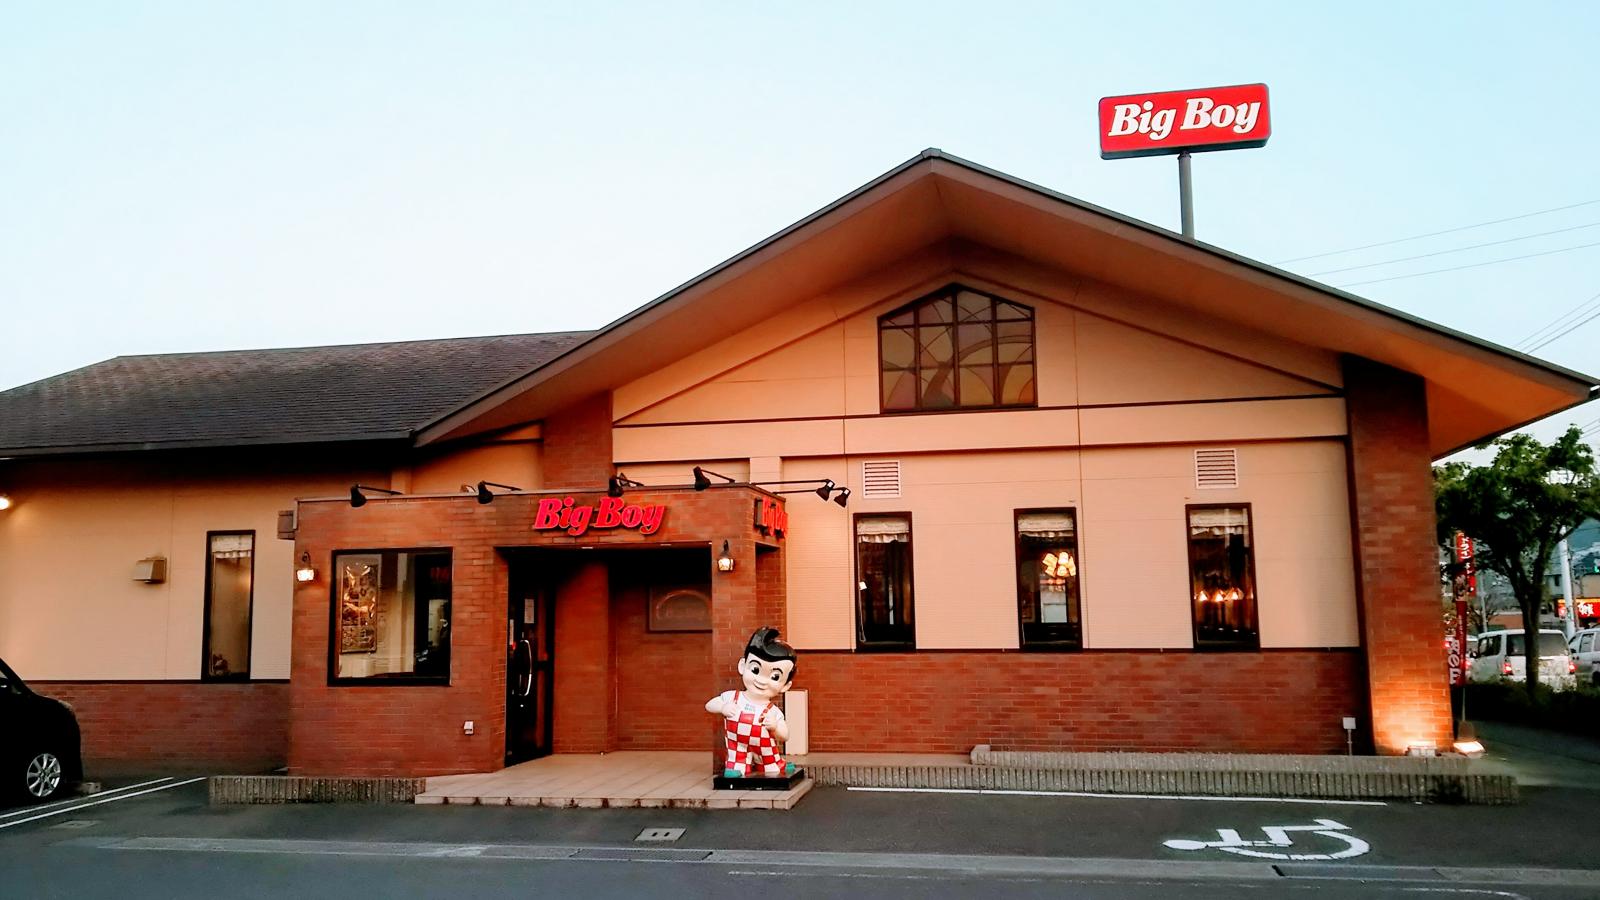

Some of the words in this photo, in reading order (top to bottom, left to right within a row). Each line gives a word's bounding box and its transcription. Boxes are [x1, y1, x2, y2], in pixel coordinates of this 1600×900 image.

[1107, 100, 1177, 141] Big
[1179, 97, 1262, 134] Boy
[533, 496, 593, 536] Big
[593, 496, 666, 535] Boy
